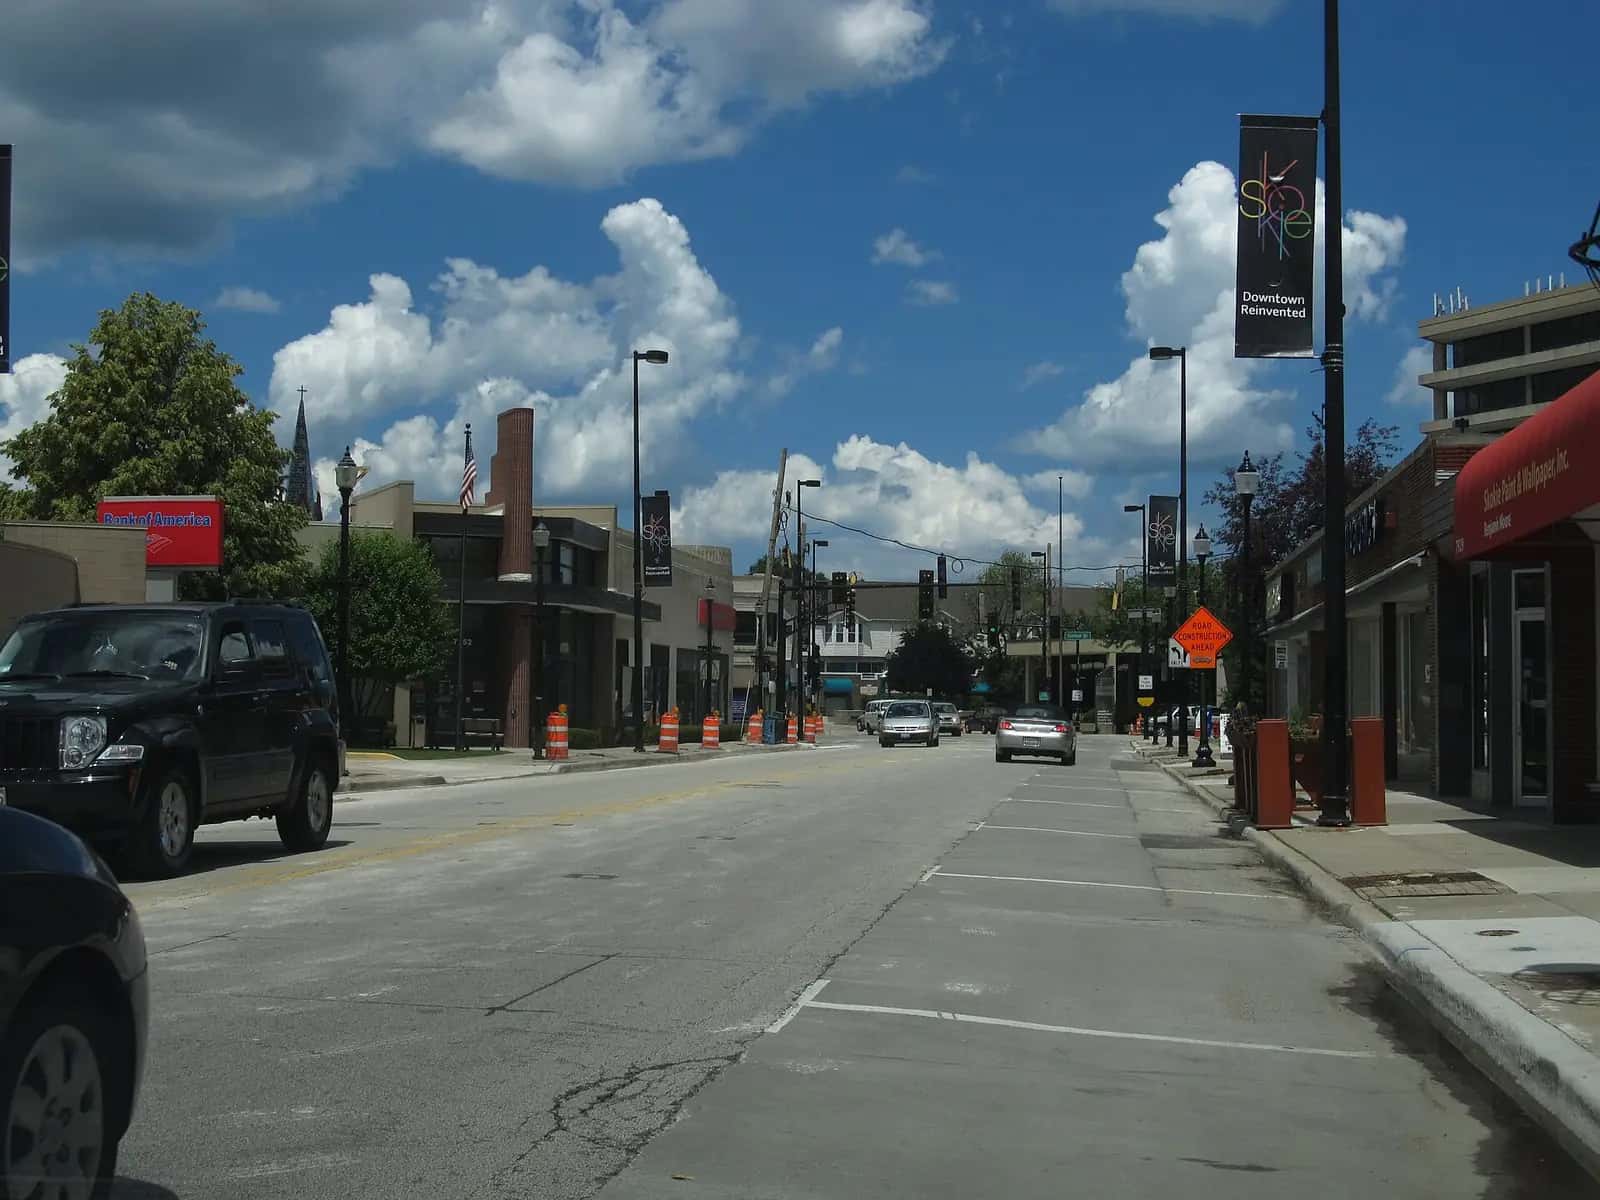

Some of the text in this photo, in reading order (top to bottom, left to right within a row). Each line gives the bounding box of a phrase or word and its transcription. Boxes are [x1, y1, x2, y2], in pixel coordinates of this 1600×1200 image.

[1242, 291, 1305, 305] Downtown
[1240, 304, 1306, 318] Reinvented
[1483, 447, 1569, 512] Skokie Paint & Wallpaper, Inc.
[103, 511, 212, 527] Bank of America
[1192, 622, 1212, 630] ROAD
[1178, 631, 1227, 641] CONSTRUCTION
[1191, 643, 1215, 651] AHEAD
